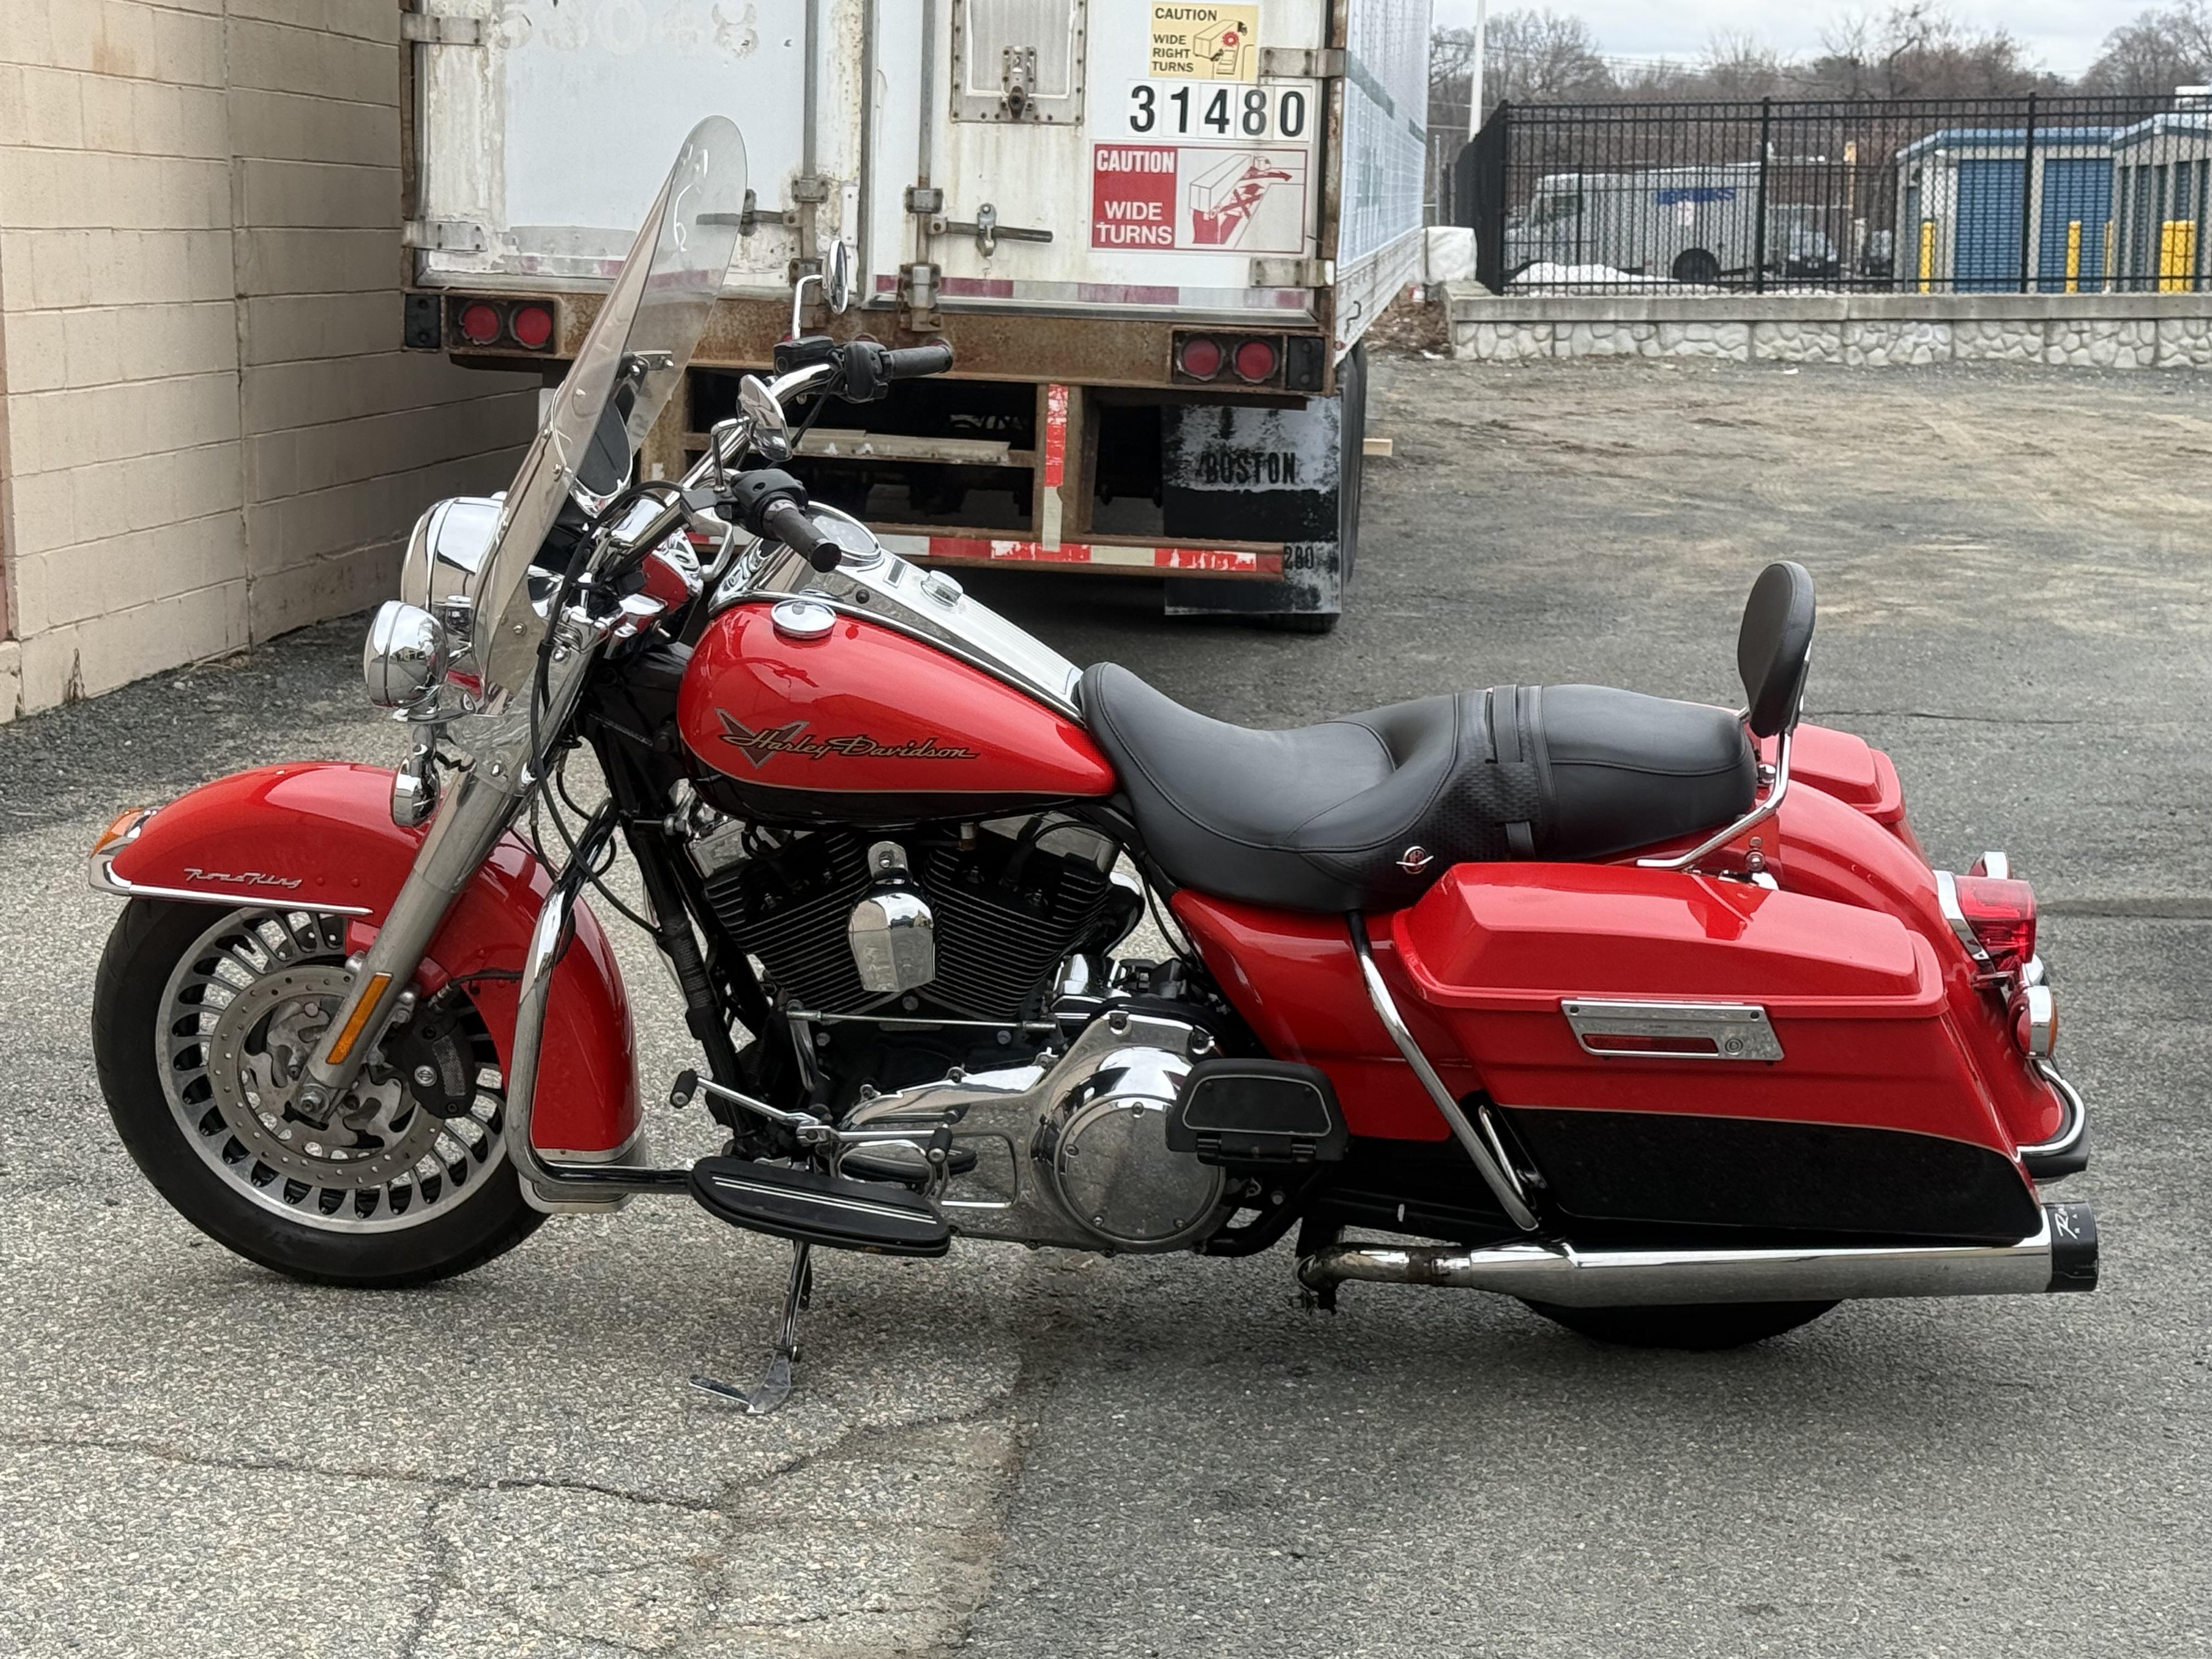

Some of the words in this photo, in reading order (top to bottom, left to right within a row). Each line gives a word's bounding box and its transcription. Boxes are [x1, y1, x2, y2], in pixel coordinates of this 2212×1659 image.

[1154, 7, 1217, 21] CAUTION
[1153, 33, 1187, 46] WIDE
[1153, 47, 1191, 59] RIGHT
[1152, 60, 1194, 72] TURNS
[1130, 85, 1305, 137] 31480
[1097, 149, 1175, 173] CAUTION
[1104, 201, 1163, 221] WIDE
[1096, 222, 1172, 245] TURNS
[1206, 451, 1296, 484] BOSTON
[719, 729, 979, 759] Harley-Davidson
